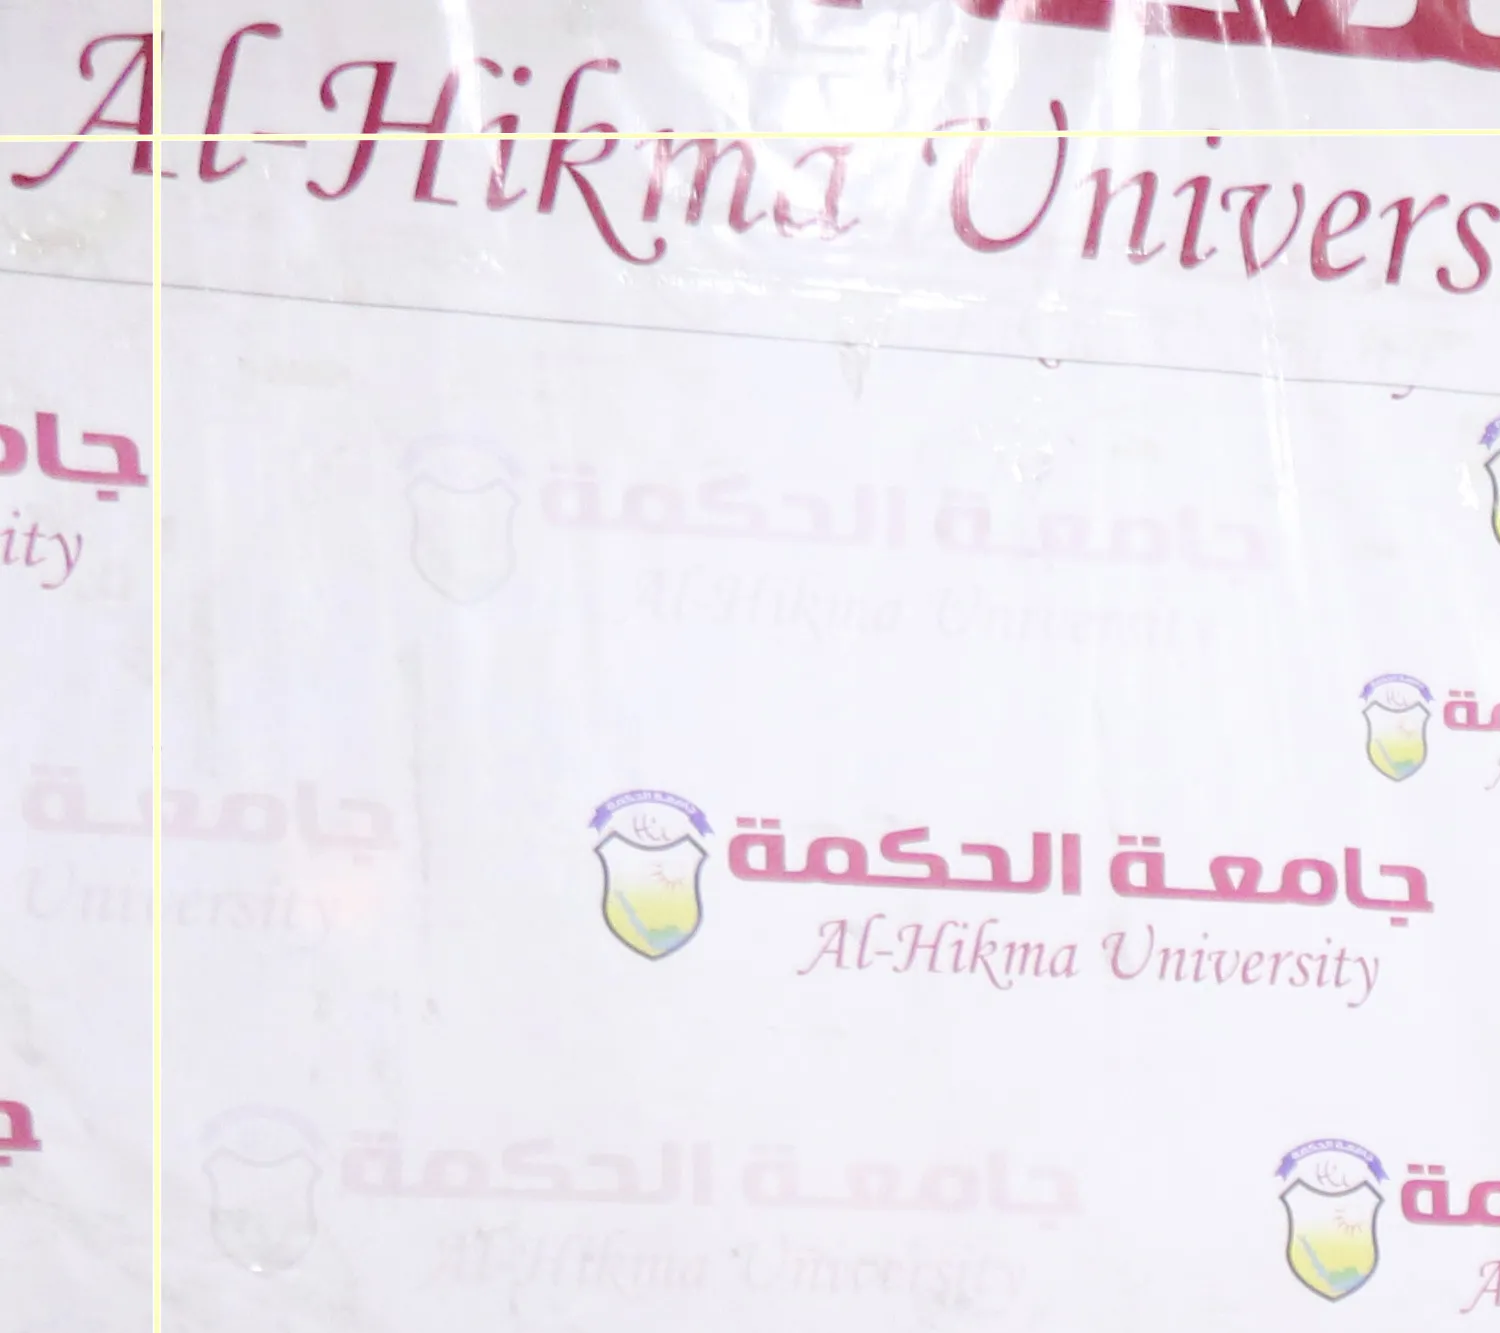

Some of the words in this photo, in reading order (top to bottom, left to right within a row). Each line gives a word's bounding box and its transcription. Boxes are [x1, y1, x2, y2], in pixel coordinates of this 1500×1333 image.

[11, 22, 861, 265] Al-Hikma
[727, 816, 1081, 895] الحكمة
[1109, 834, 1434, 927] جامعة
[796, 912, 1078, 991] Al-Hikma
[1101, 923, 1379, 1009] University
